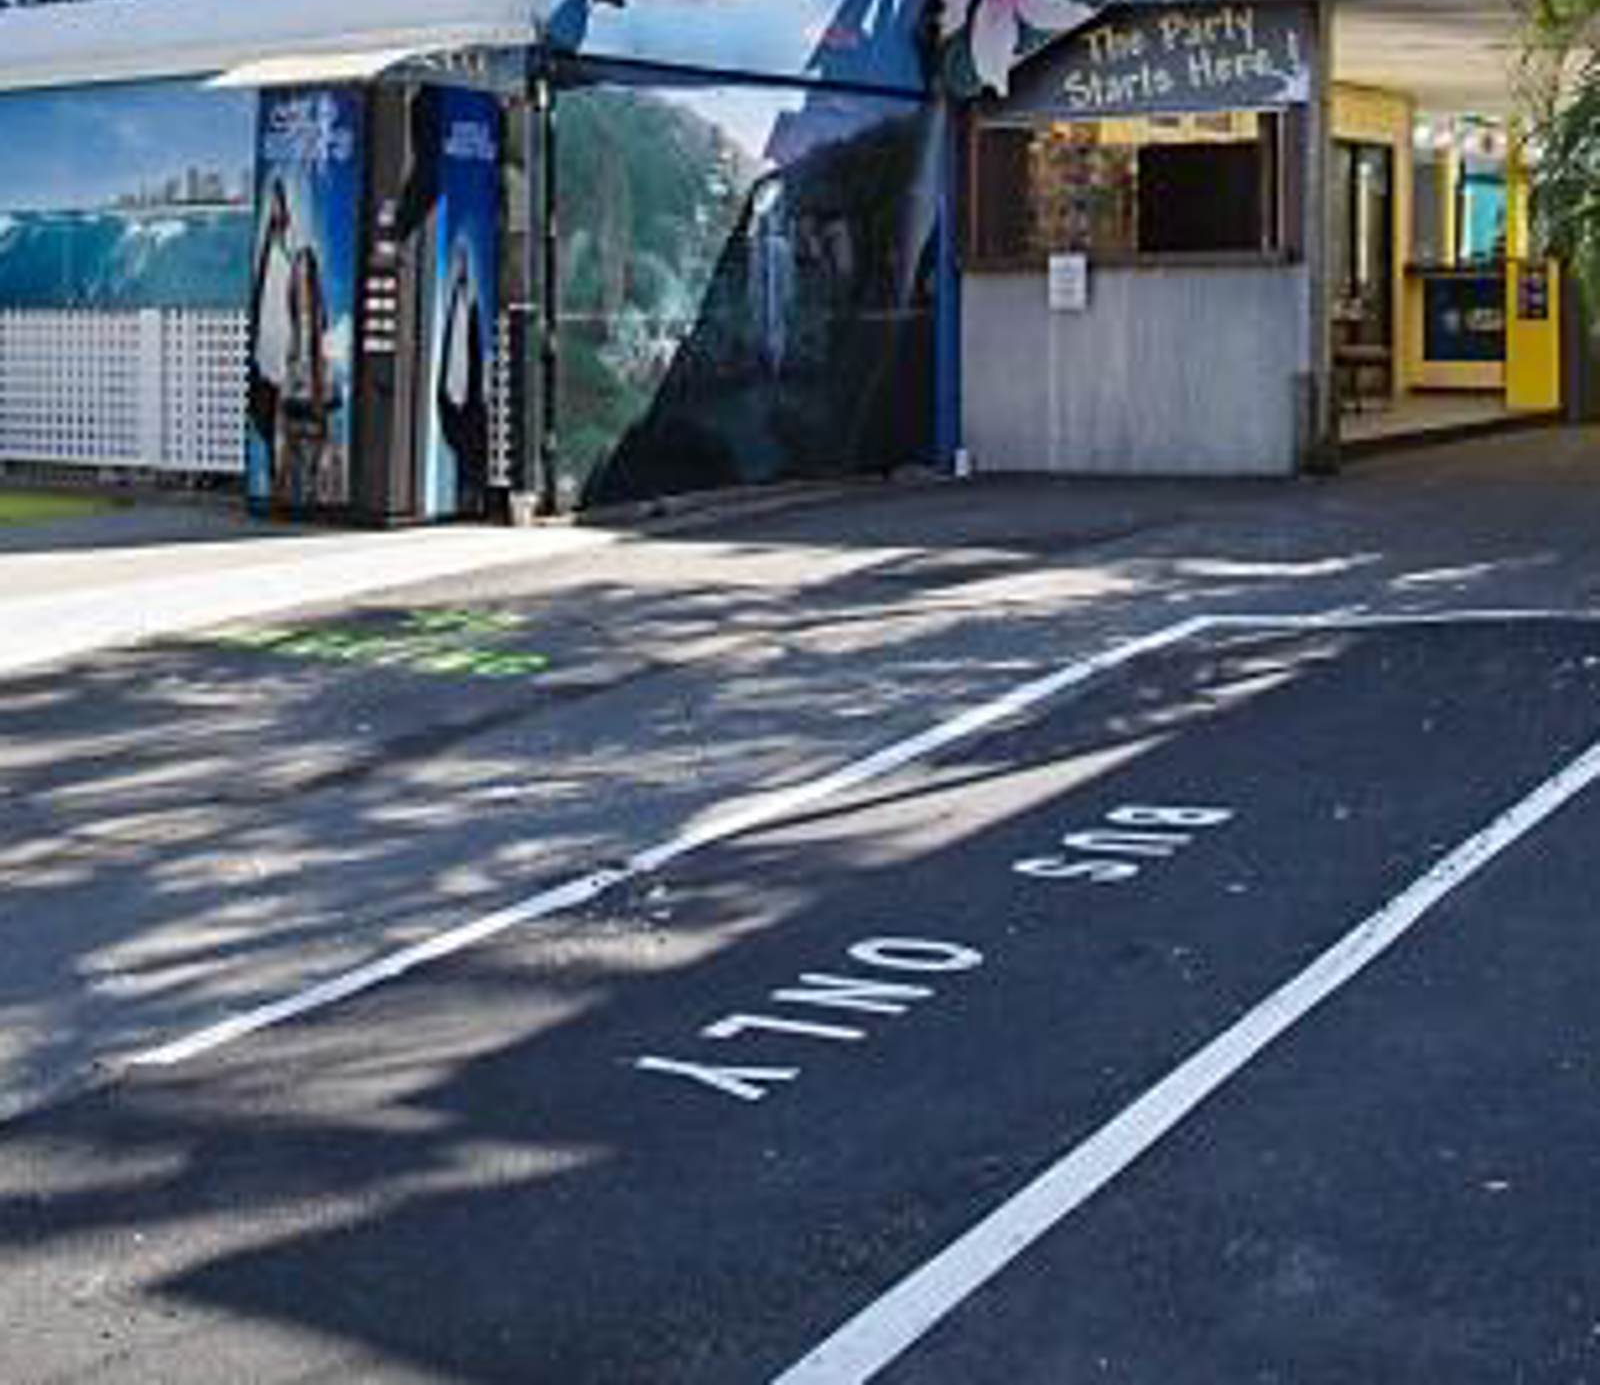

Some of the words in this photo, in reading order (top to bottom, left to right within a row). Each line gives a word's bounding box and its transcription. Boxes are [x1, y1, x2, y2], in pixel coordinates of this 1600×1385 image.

[1081, 26, 1144, 63] The
[1158, 7, 1253, 51] Party
[1063, 61, 1174, 109] Starts
[1011, 806, 1234, 881] BUS
[634, 936, 984, 1101] ONLY
